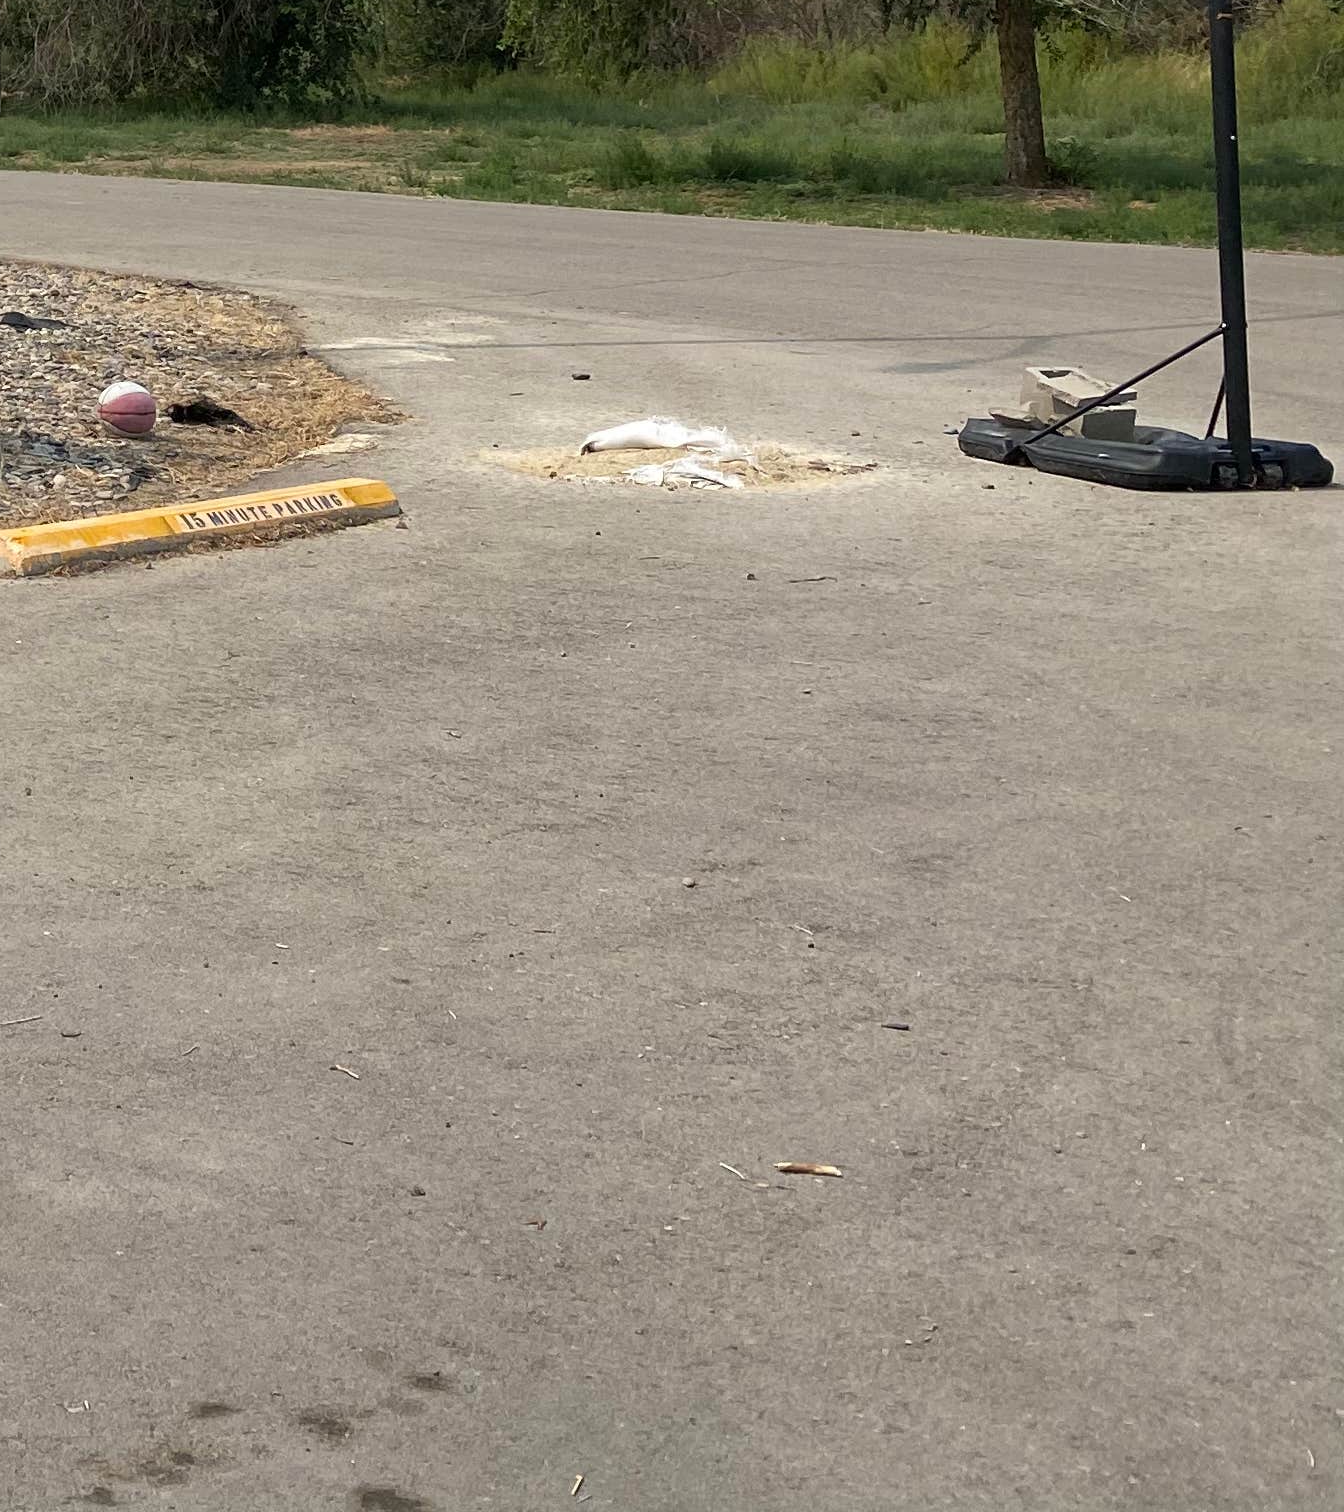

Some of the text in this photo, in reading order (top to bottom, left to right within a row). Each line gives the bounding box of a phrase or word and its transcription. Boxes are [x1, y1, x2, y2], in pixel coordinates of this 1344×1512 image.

[179, 493, 343, 530] 15 MINUTE PARKING
